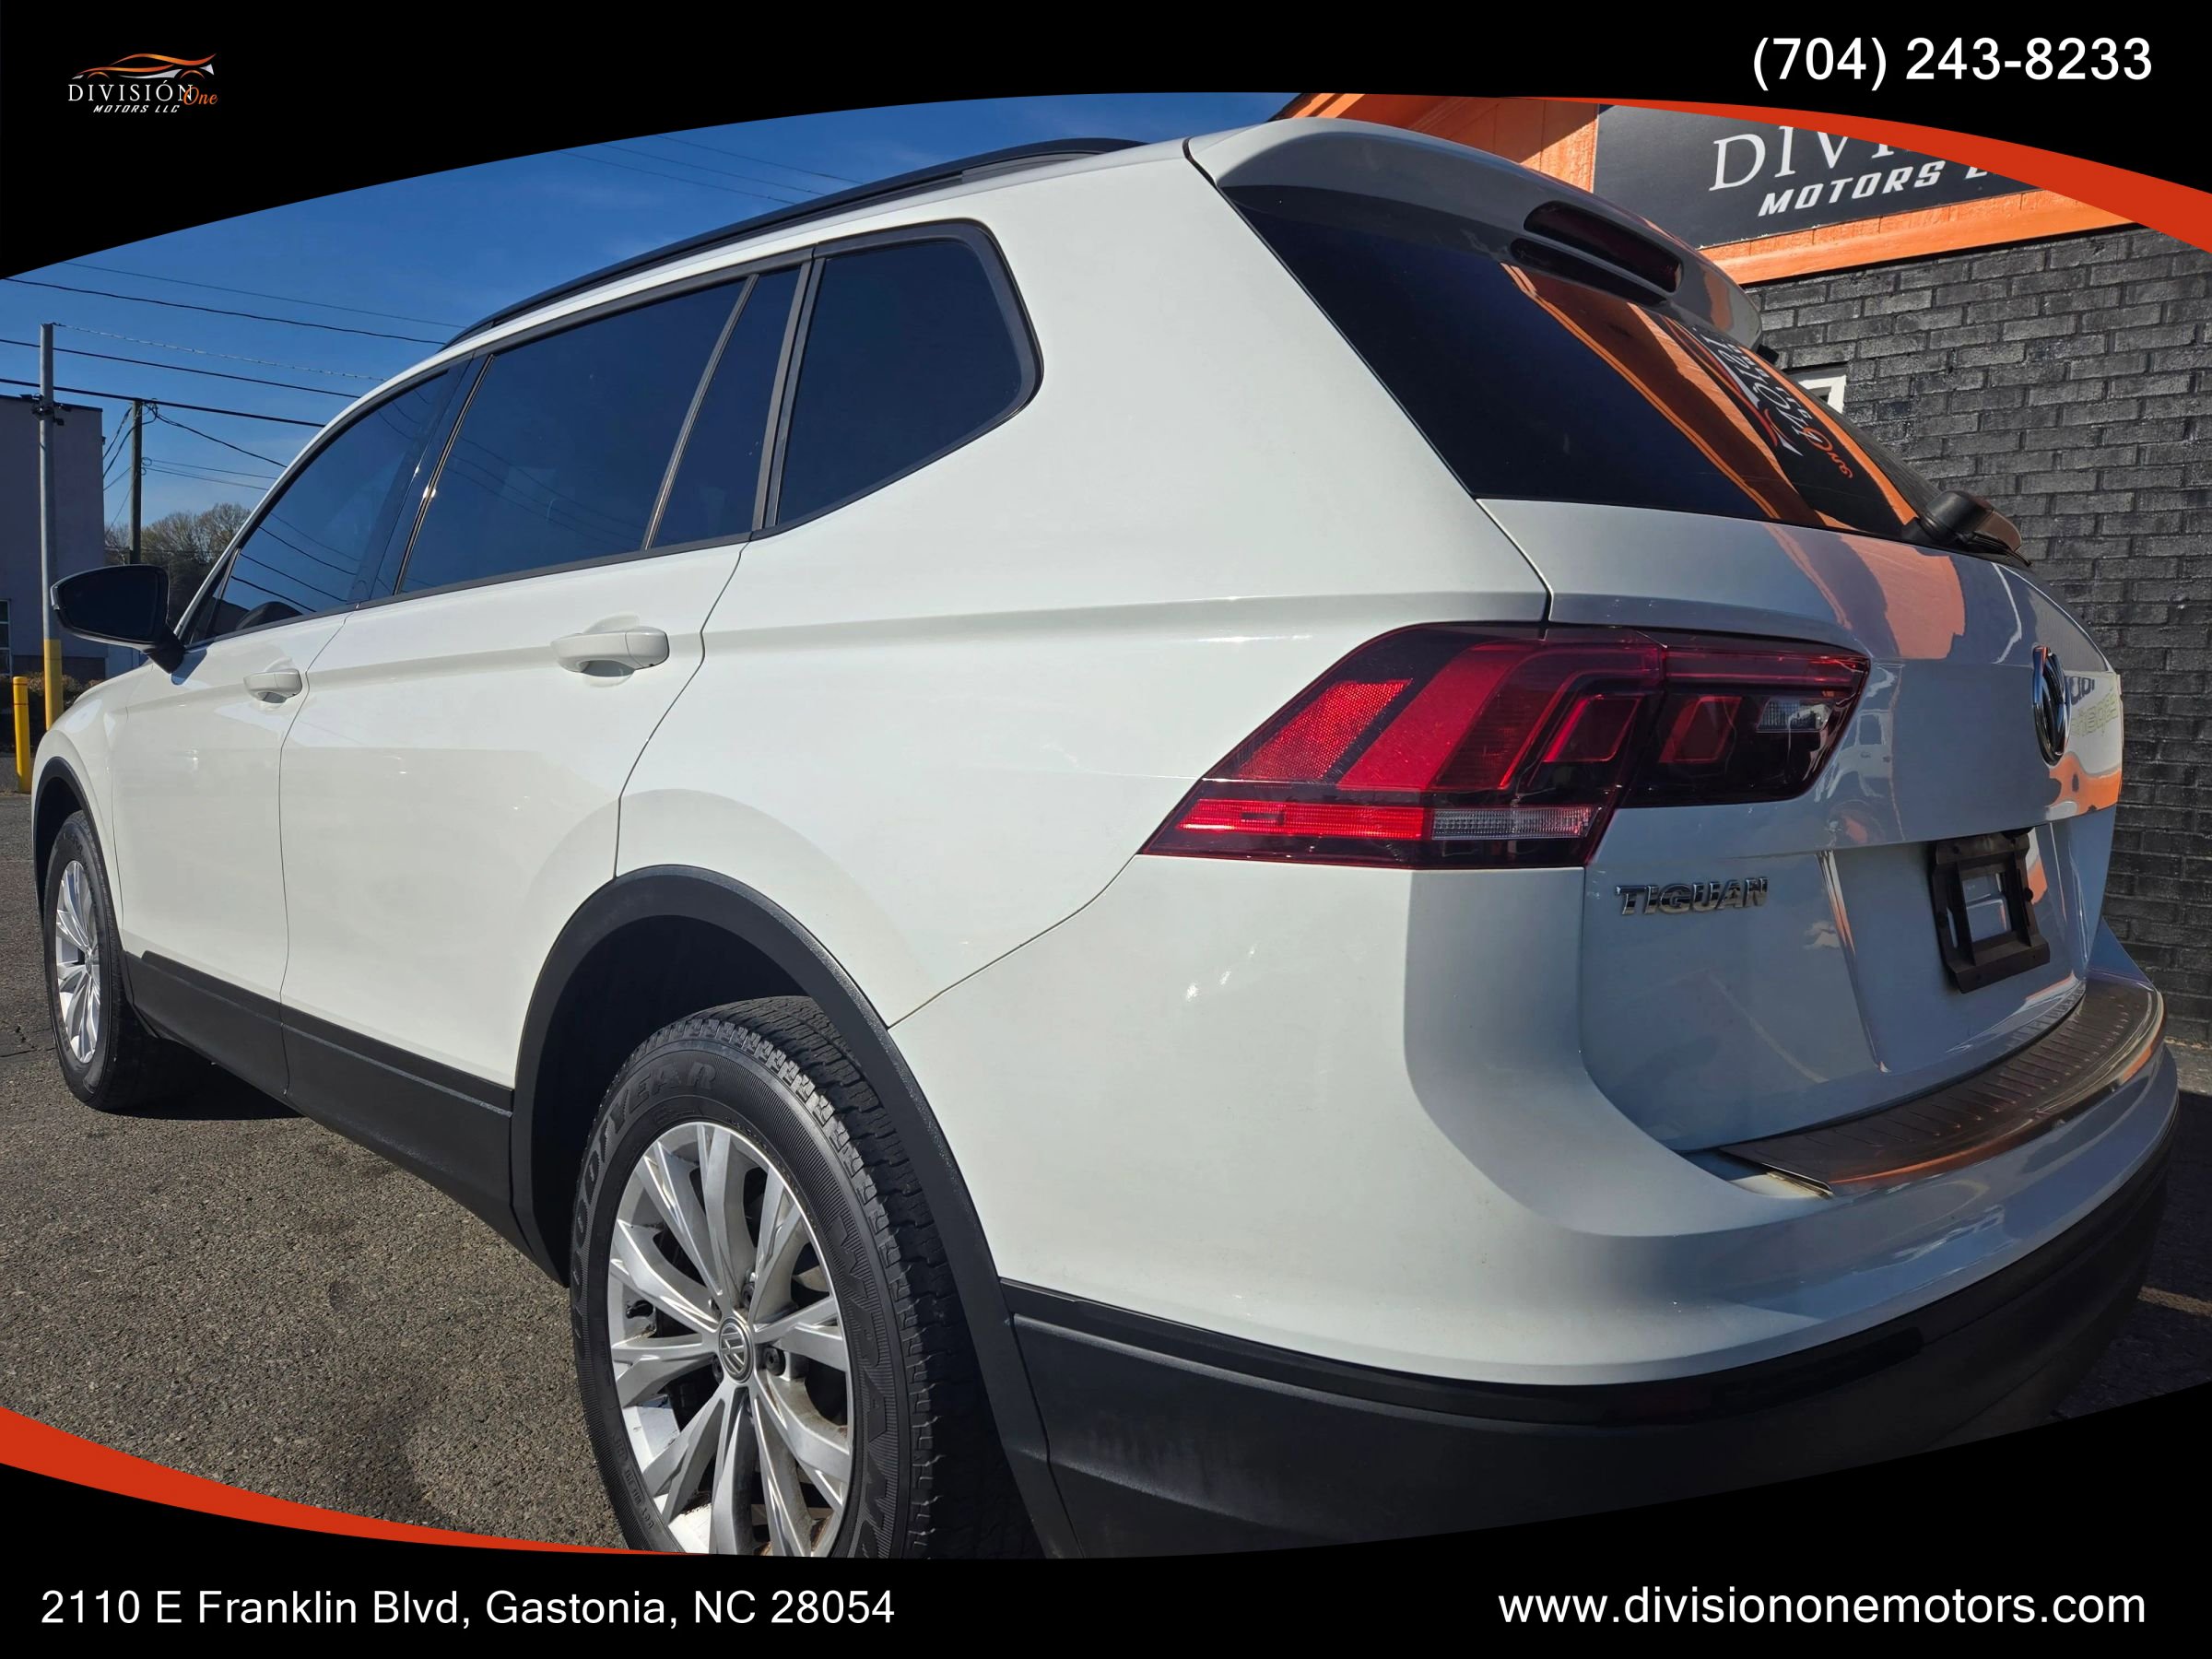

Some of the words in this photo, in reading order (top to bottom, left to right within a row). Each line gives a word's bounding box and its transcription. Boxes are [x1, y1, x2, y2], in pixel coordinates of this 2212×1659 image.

[1709, 125, 1894, 191] DIV
[1758, 160, 1946, 217] MOTORS
[1616, 877, 1768, 915] TIGUAN
